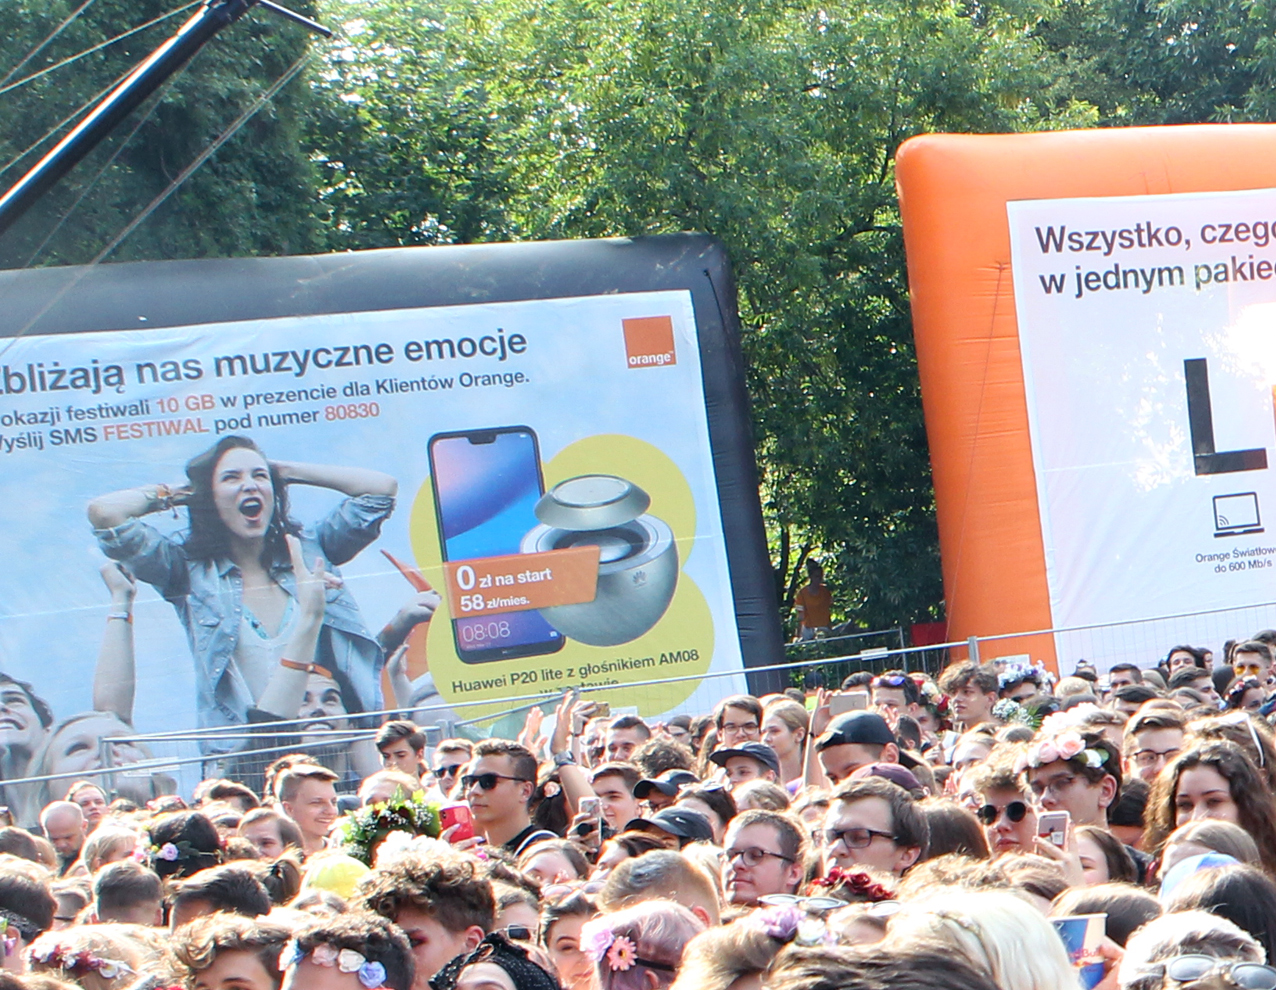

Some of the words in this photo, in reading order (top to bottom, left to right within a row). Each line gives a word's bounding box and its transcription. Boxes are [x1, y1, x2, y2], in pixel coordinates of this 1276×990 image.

[1035, 221, 1191, 257] Wszystko,
[1039, 273, 1066, 294] w
[1075, 263, 1185, 299] jednym
[0, 359, 125, 395] bliżają
[137, 358, 204, 384] nas
[214, 341, 394, 377] muzyczne
[405, 328, 527, 361] emocje
[1, 407, 61, 427] okazji
[66, 400, 150, 421] festiwali
[157, 397, 179, 414] 10
[185, 394, 216, 411] GB
[221, 396, 238, 407] w
[243, 384, 337, 409] prezencie
[343, 381, 371, 397] dla
[376, 375, 454, 394] Klientów
[459, 372, 530, 388] Orange.
[0, 431, 44, 453] yślij
[50, 426, 98, 446] SMS
[103, 417, 209, 441] FESTIWAL
[214, 413, 252, 434] pod
[258, 409, 320, 428] numer
[325, 402, 380, 421] 80830
[1195, 550, 1231, 564] Orange
[1214, 562, 1228, 573] do
[1228, 561, 1246, 572] 600
[1248, 558, 1273, 571] Mb/s
[457, 565, 475, 591] 0
[479, 575, 492, 588] zł
[495, 575, 515, 586] na
[517, 567, 553, 584] start
[460, 595, 485, 612] 58
[487, 594, 530, 609] zł/mies.
[462, 621, 511, 643] 08:08
[452, 674, 507, 694] Huawei
[510, 671, 538, 686] P20
[541, 666, 563, 682] lite
[566, 667, 575, 678] z
[579, 656, 655, 682] głośnikiem
[658, 649, 699, 666] AM08
